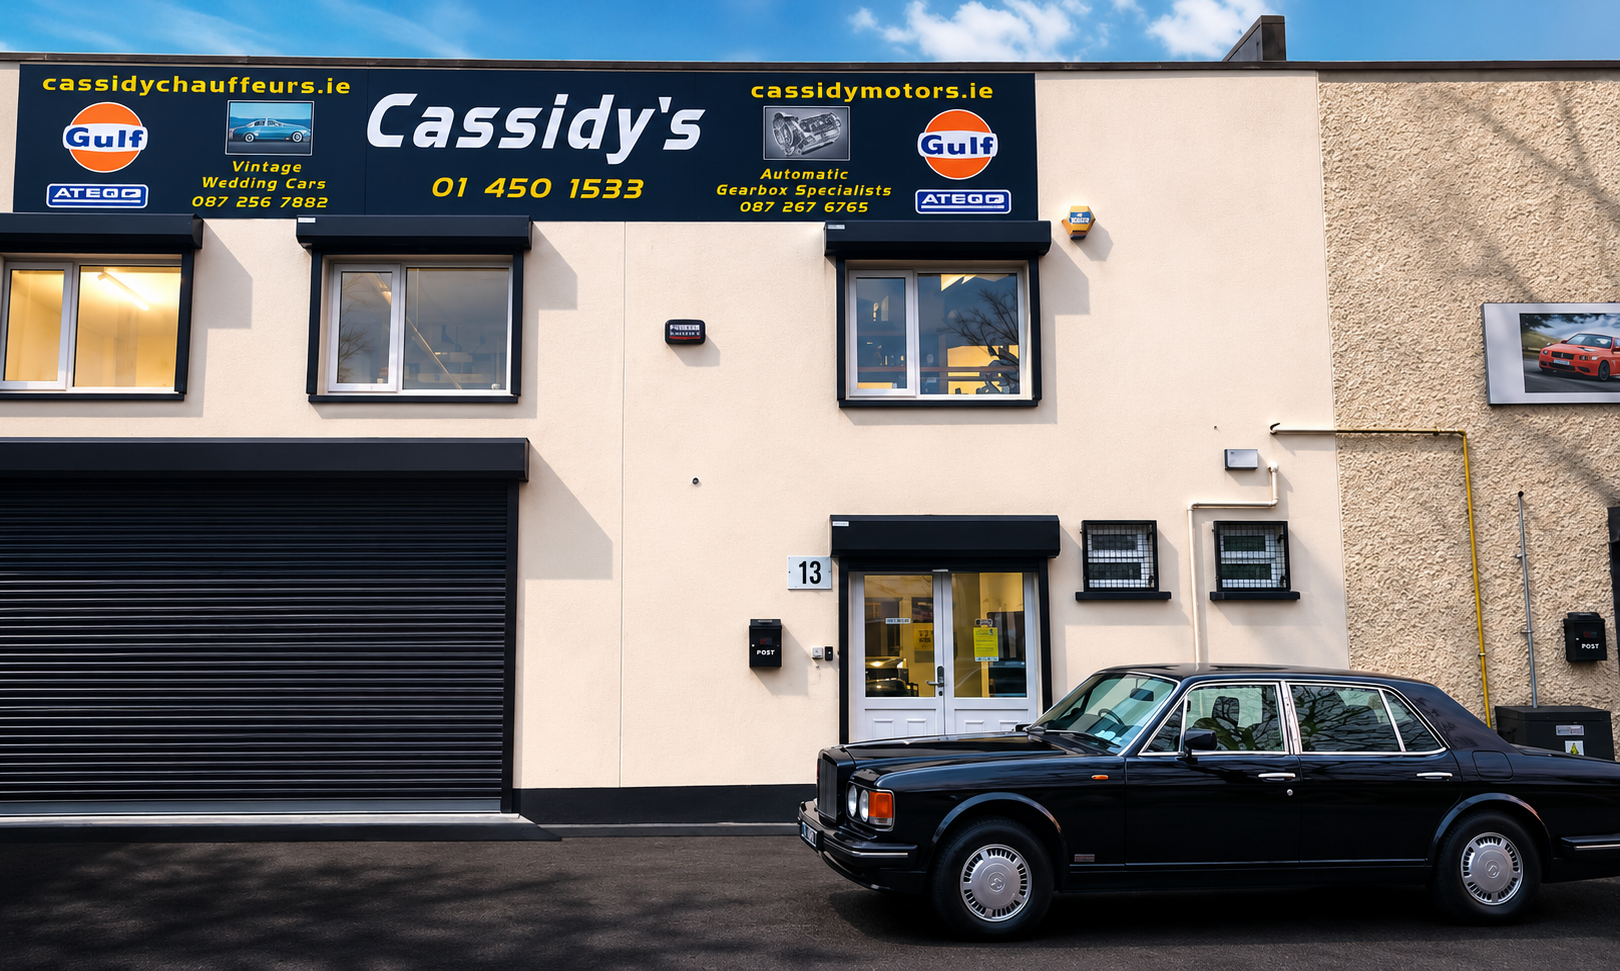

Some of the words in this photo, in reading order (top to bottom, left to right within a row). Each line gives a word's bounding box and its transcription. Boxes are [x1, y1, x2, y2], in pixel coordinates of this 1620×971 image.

[42, 74, 351, 97] cassidychauffeurs.ie
[751, 81, 994, 103] cassidymotors.ie
[65, 126, 145, 149] Gulf
[366, 93, 706, 165] Cassidy's
[920, 134, 995, 156] Gulf
[232, 160, 302, 175] Vintage
[760, 168, 849, 180] Automatic
[202, 176, 278, 192] Wedding
[285, 177, 326, 190] Cars
[431, 176, 468, 198] 01
[484, 177, 552, 199] 450
[569, 178, 645, 199] 1533
[716, 184, 788, 196] Gearbox
[794, 184, 892, 199] Specialists
[191, 195, 229, 208] 087
[235, 196, 272, 208] 256
[280, 196, 329, 209] 7882
[739, 201, 776, 213] 087
[782, 201, 817, 213] 267
[824, 201, 869, 213] 6765
[798, 560, 822, 585] 13
